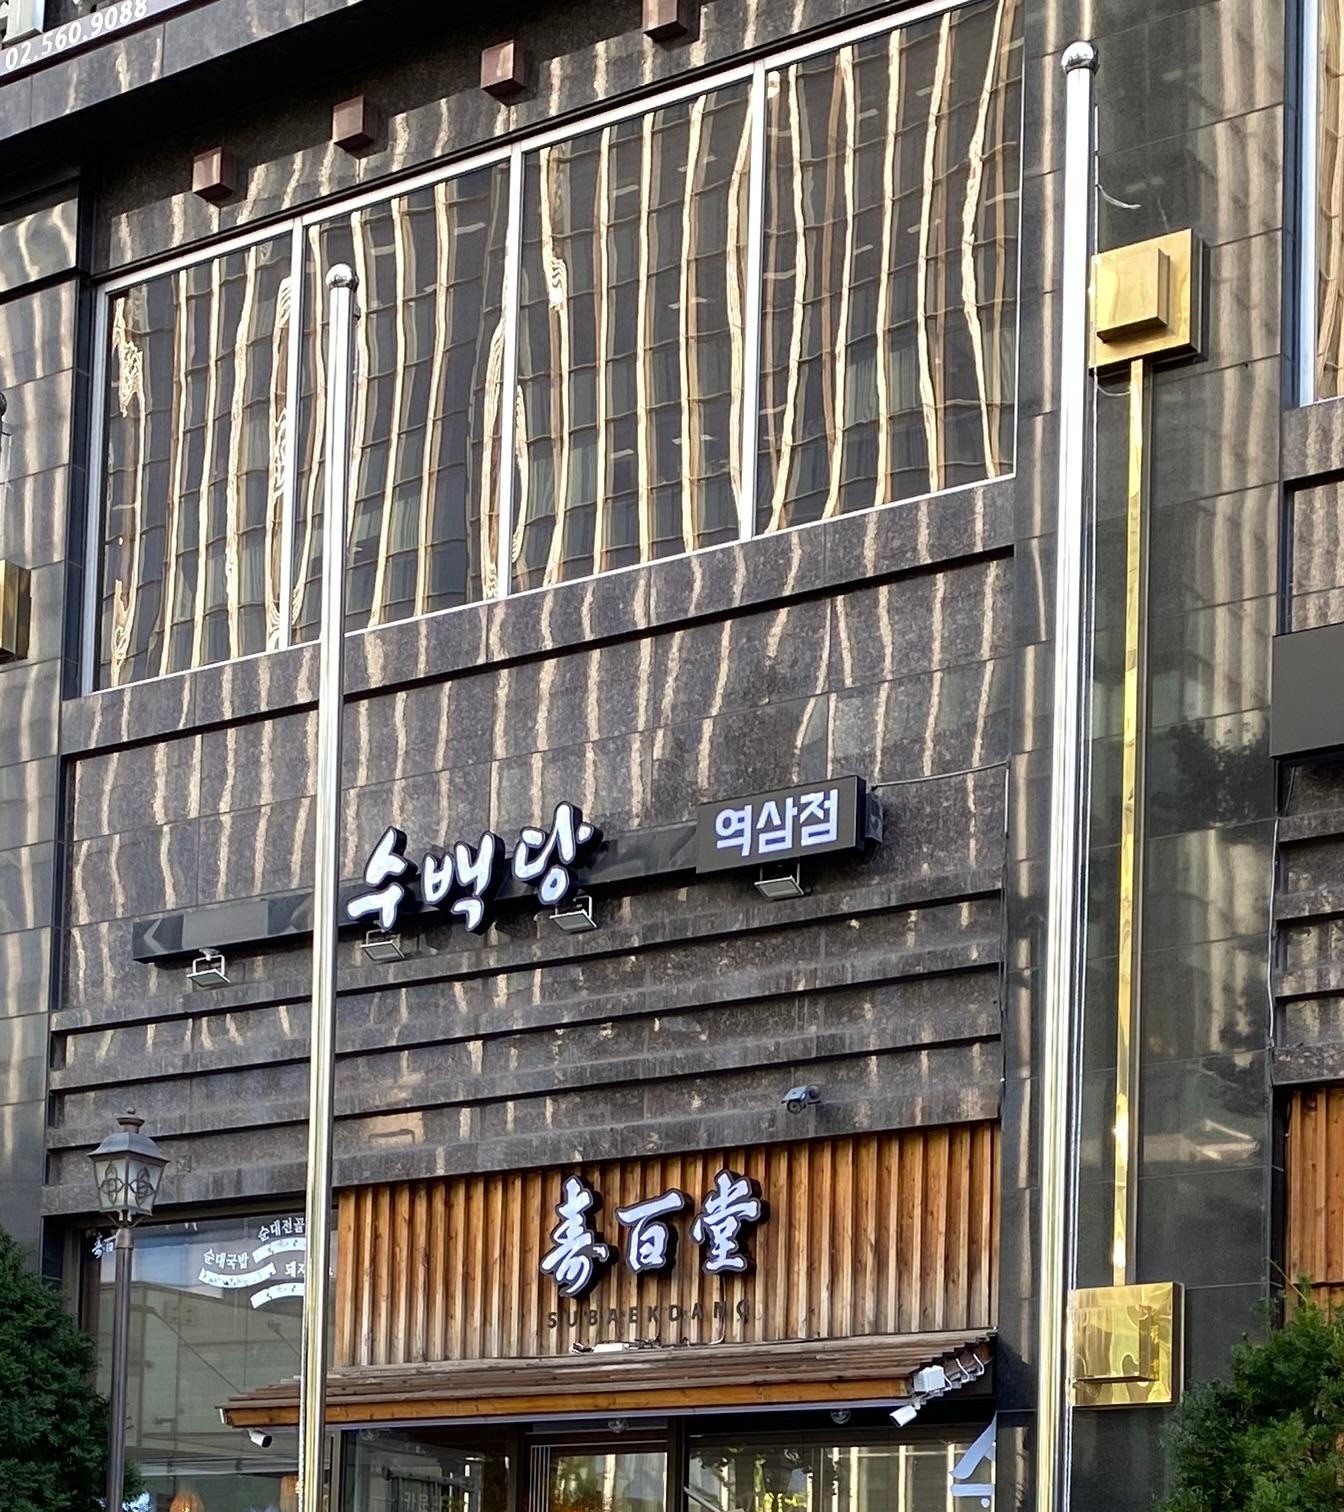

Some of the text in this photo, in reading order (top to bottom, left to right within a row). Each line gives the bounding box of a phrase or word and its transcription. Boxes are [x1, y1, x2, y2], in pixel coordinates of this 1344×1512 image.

[4, 0, 149, 72] 02.560.9088
[714, 789, 840, 857] 역삼점
[346, 800, 594, 933] 수백당
[257, 1215, 306, 1242] 순대전골
[202, 1248, 250, 1270] 순대국밥
[547, 1299, 751, 1330] SUBAEKDANG
